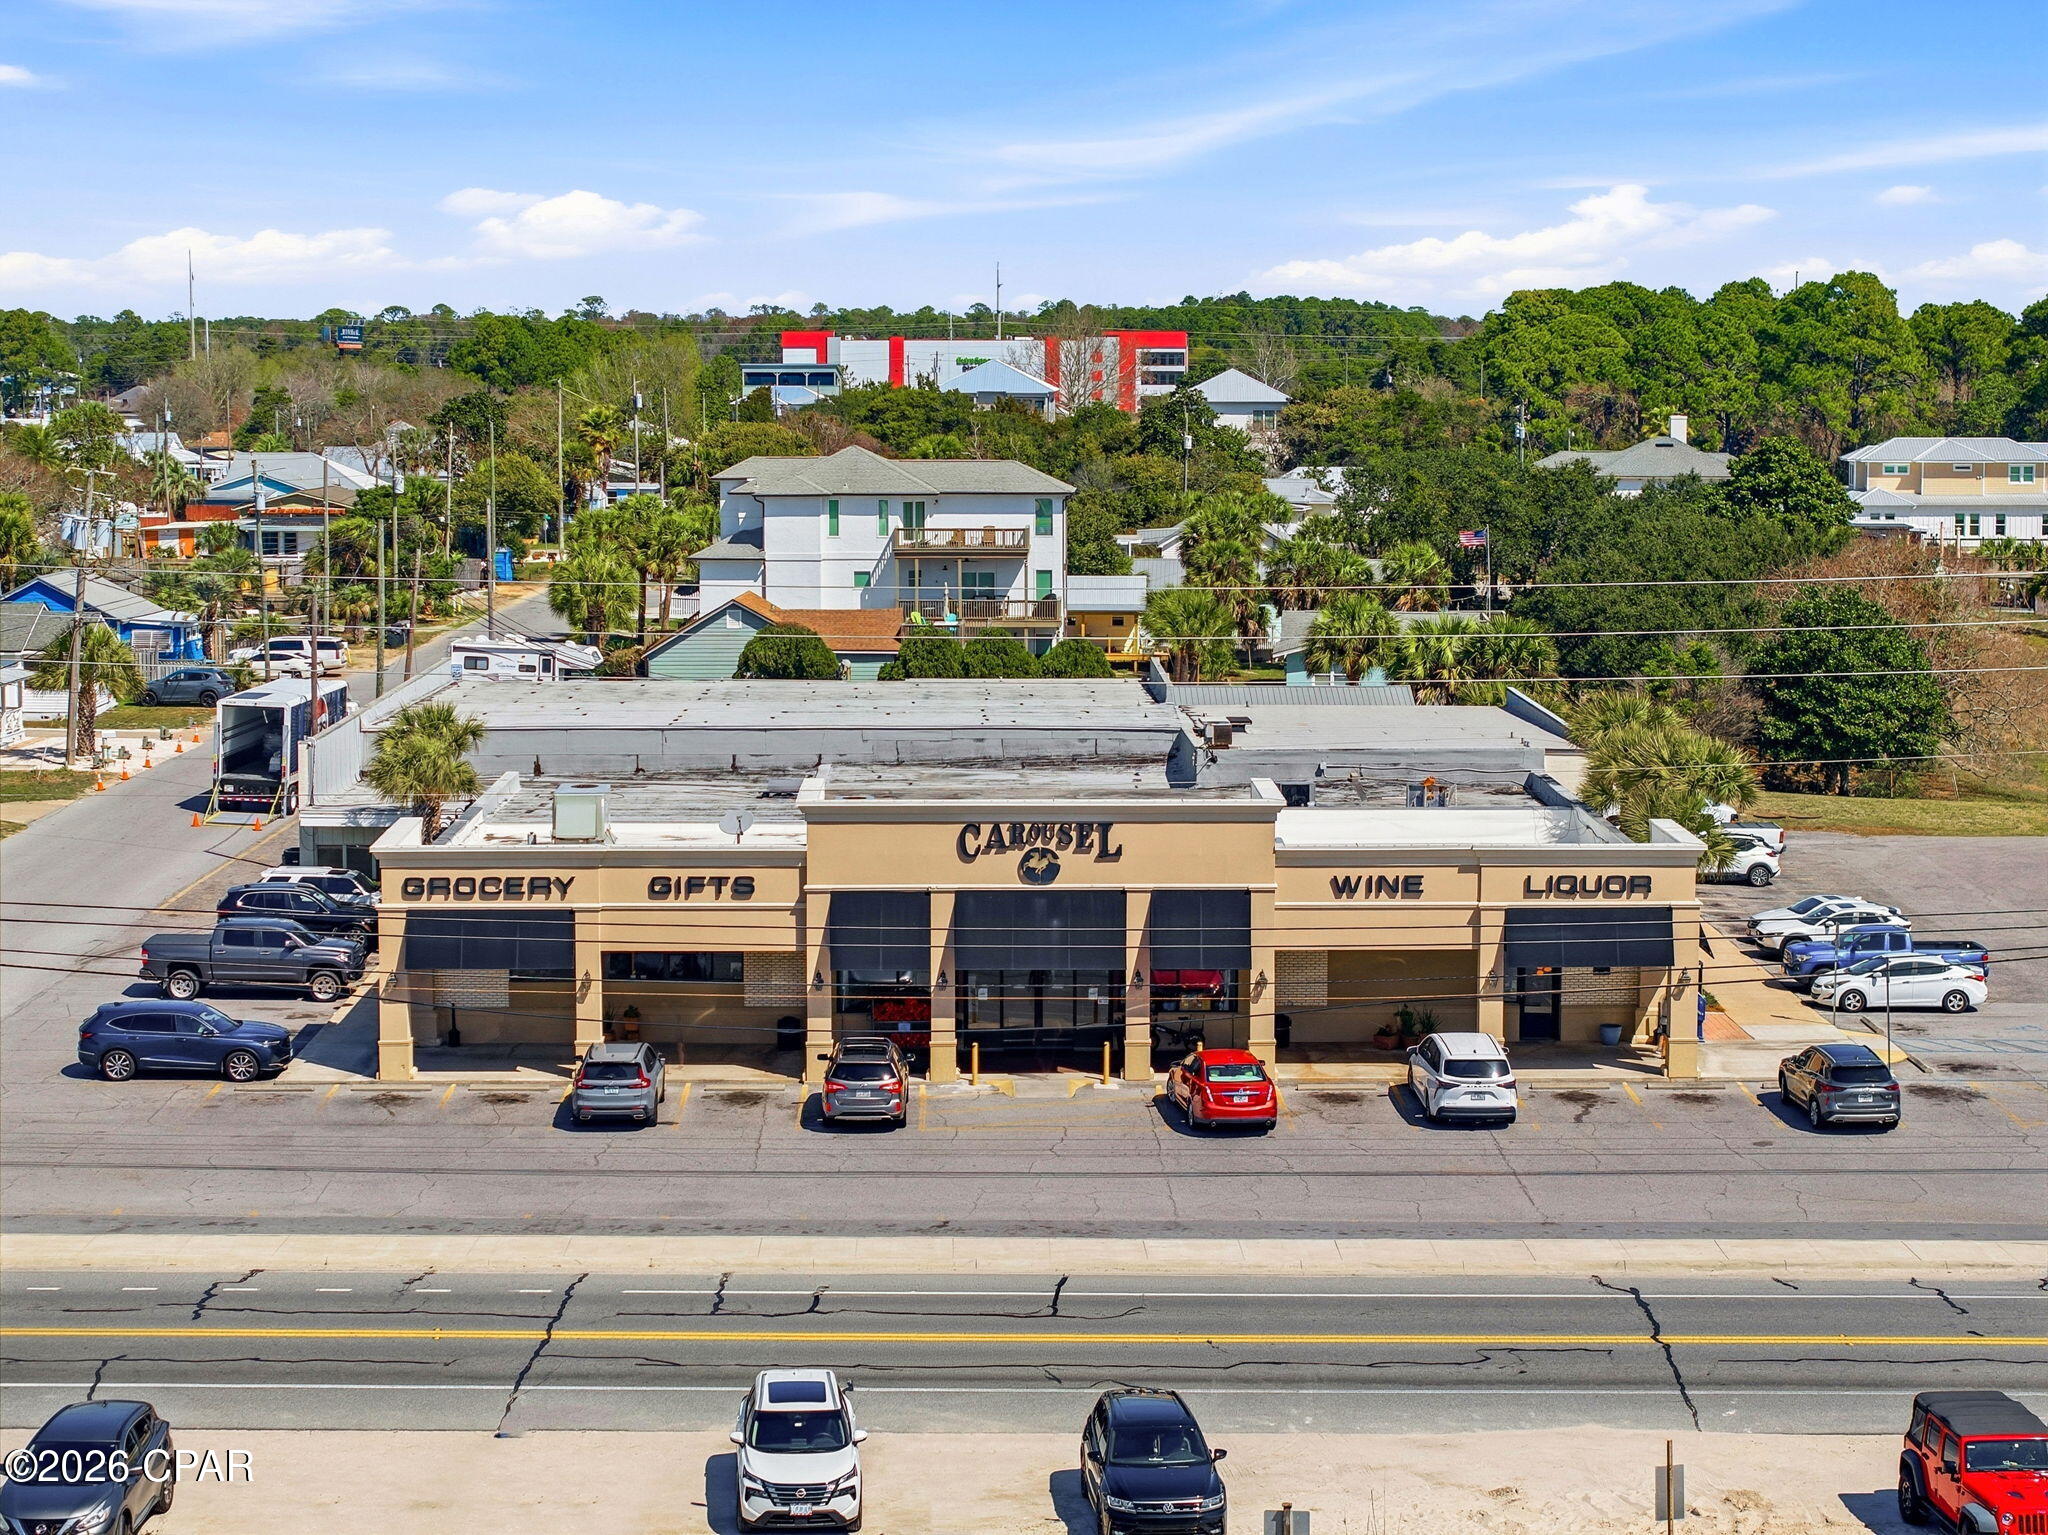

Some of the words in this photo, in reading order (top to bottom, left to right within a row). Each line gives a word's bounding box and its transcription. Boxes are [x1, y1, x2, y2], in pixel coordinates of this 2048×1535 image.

[957, 823, 1122, 863] CAROUSEL
[402, 876, 575, 900] GROCERY
[648, 876, 755, 900] GIFTS
[1330, 875, 1424, 899] WINE
[1523, 875, 1652, 899] LIQUOR
